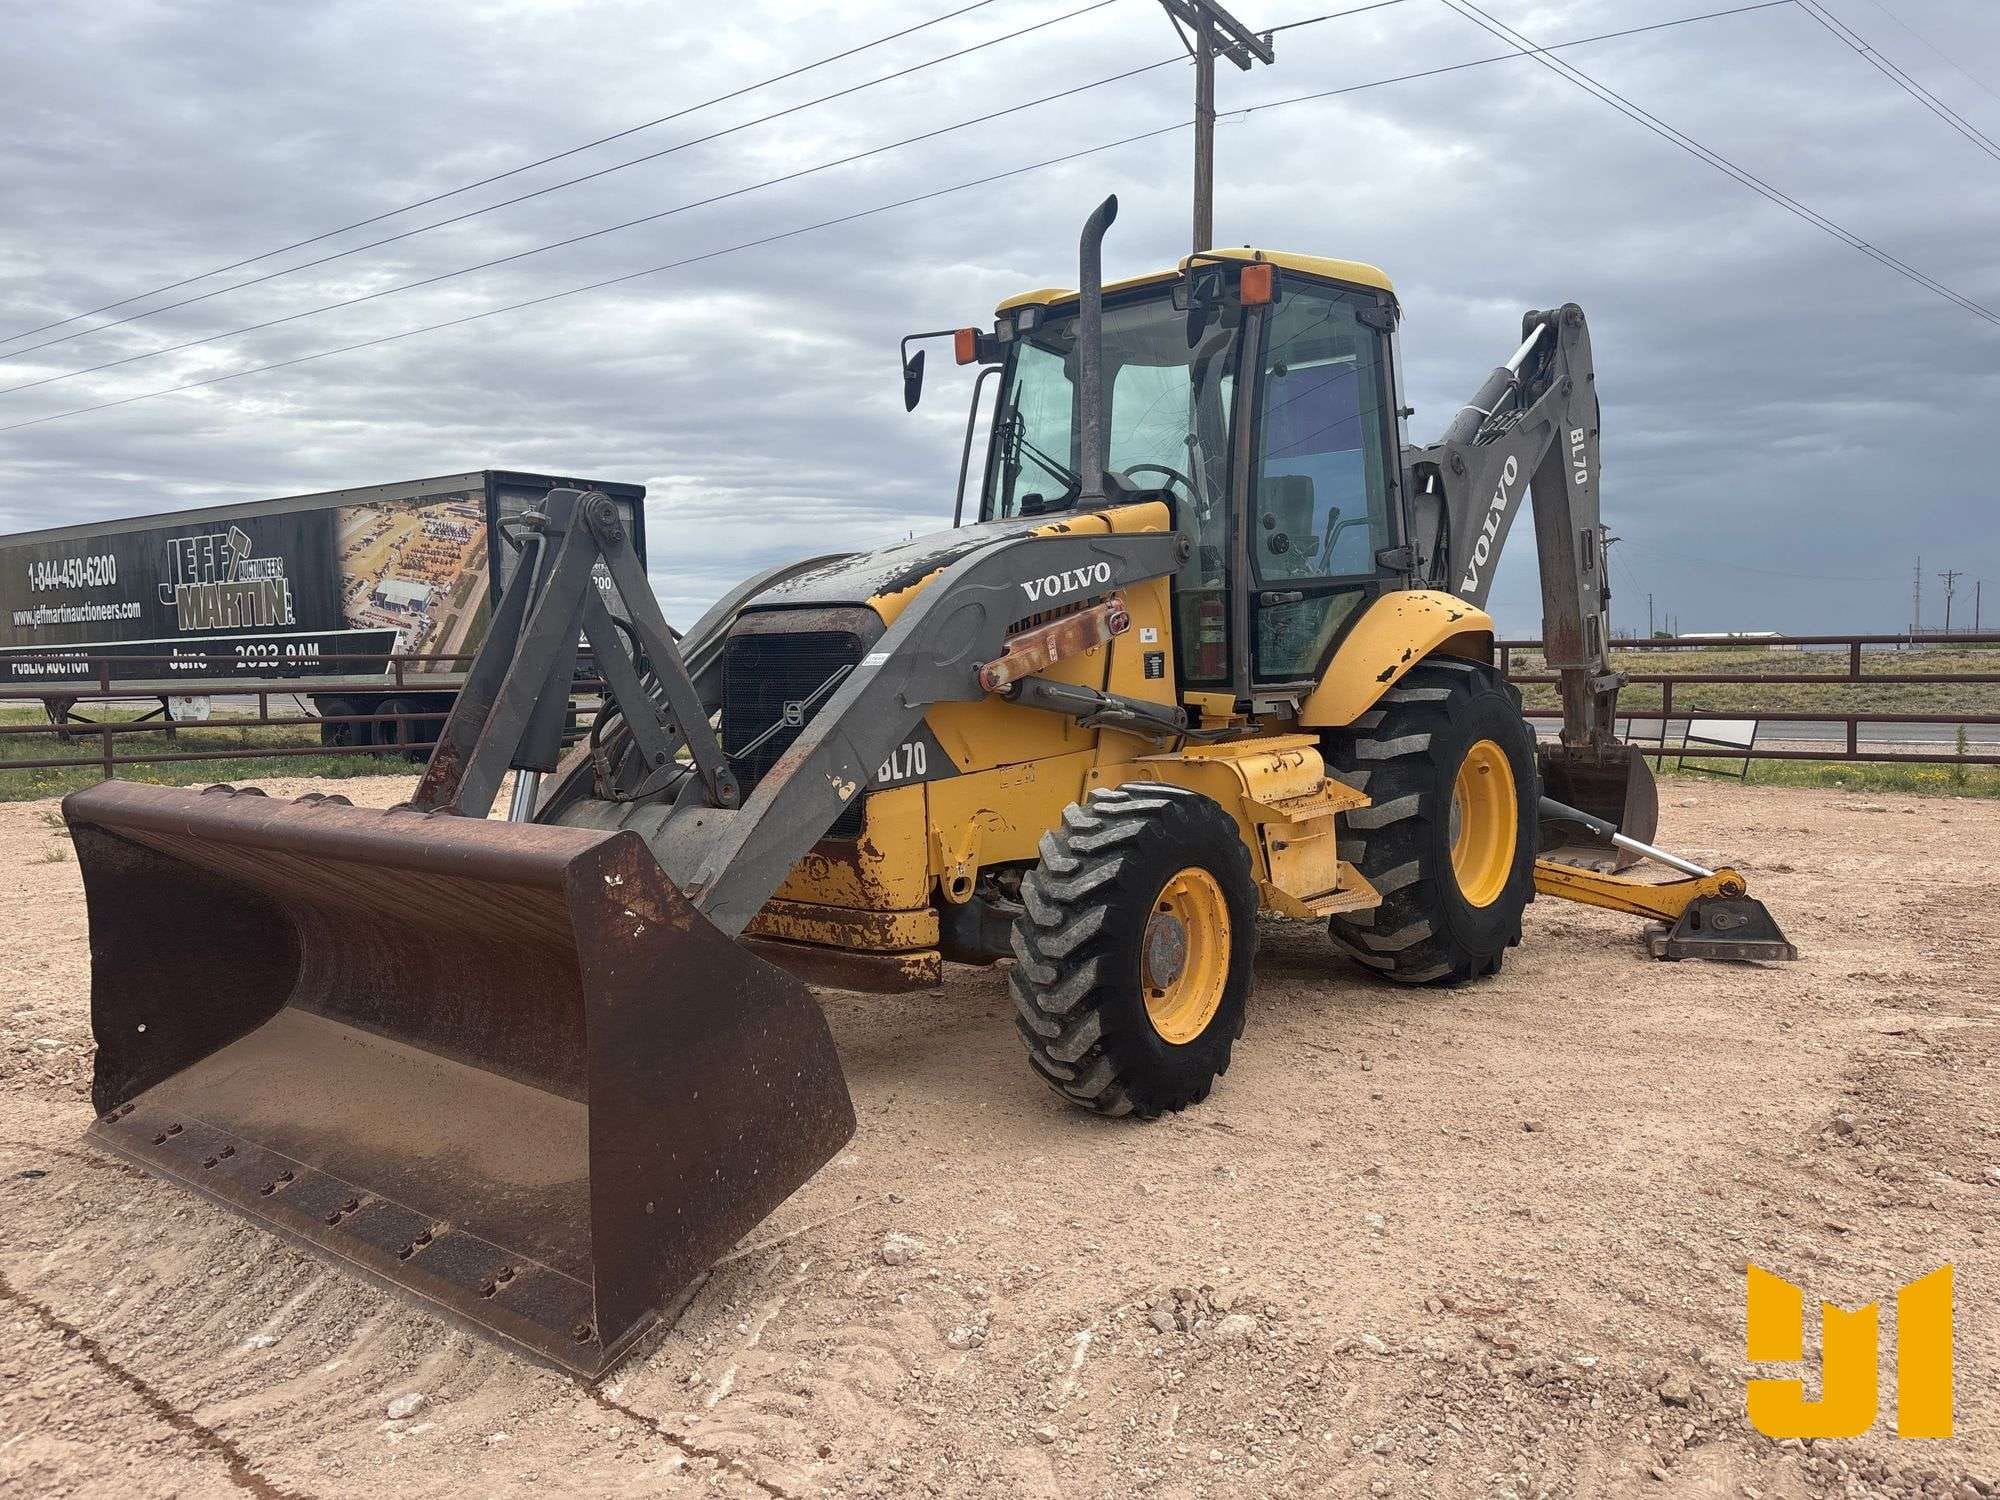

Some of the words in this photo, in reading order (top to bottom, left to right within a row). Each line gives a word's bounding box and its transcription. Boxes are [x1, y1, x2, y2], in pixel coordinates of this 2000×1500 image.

[1570, 428, 1588, 485] BL70
[1460, 455, 1518, 592] VOLVO
[28, 554, 117, 591] 1-844-450-6200
[159, 534, 230, 605] JEFF
[239, 557, 284, 580] AUCTIONEERS
[1021, 562, 1111, 601] VOLVO
[13, 601, 141, 630] www.jeffmartinauctioneers.com
[175, 577, 286, 631] MARTIN
